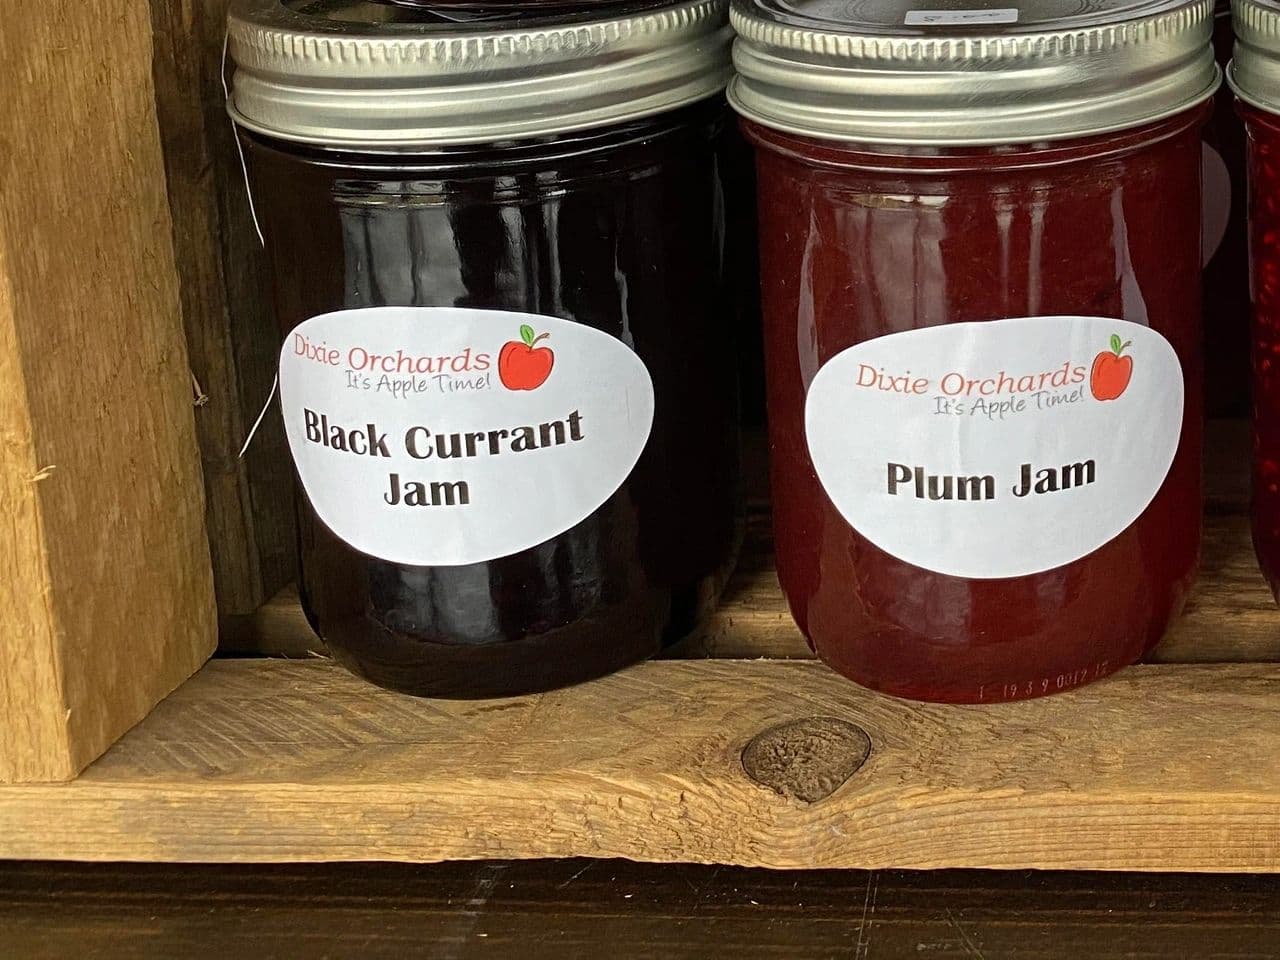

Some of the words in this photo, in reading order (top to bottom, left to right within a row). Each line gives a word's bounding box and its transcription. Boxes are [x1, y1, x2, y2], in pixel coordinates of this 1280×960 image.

[294, 333, 340, 366] Dixie
[348, 347, 491, 374] Orchards
[345, 369, 370, 391] It's
[376, 374, 428, 399] Apple
[432, 371, 492, 391] Time!
[855, 364, 929, 396] Dixie
[940, 361, 1086, 396] Orchards
[933, 396, 965, 416] It's
[970, 397, 1027, 420] Apple
[1031, 385, 1084, 410] Time!
[303, 407, 391, 458] Black
[405, 408, 585, 459] Currant
[383, 473, 470, 507] Jam
[887, 461, 995, 501] Plum
[1012, 458, 1096, 498] Jam
